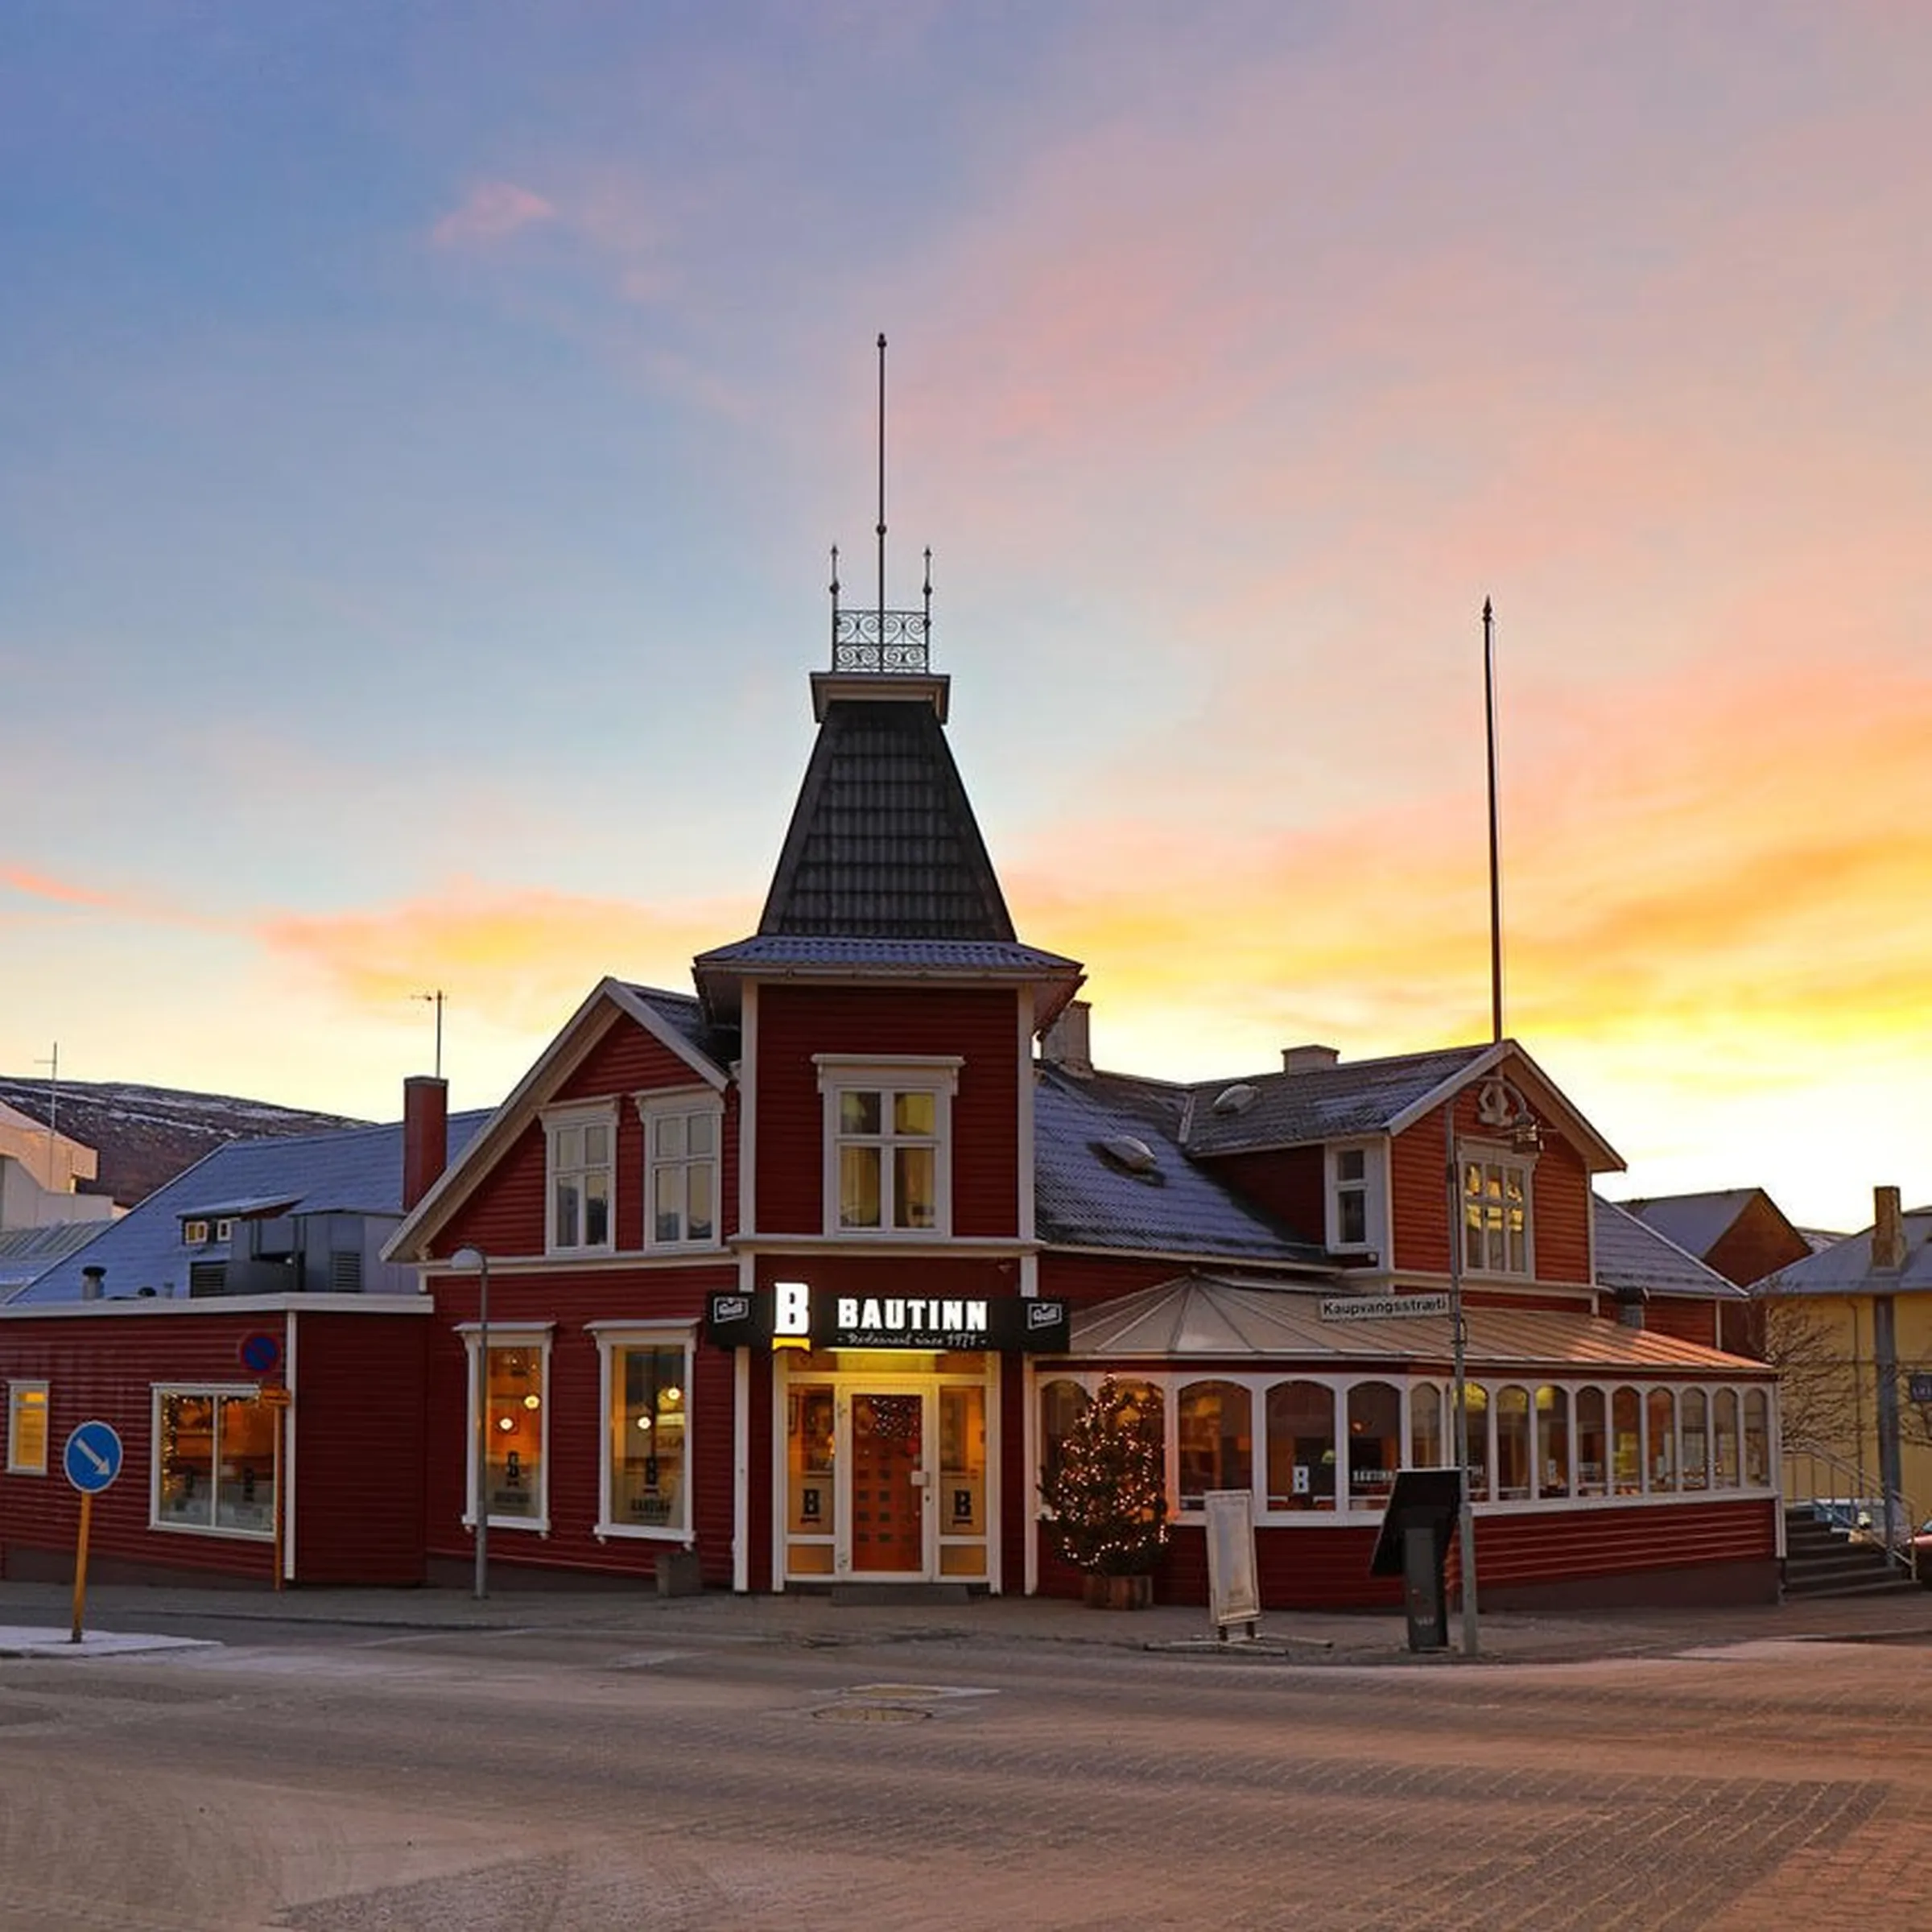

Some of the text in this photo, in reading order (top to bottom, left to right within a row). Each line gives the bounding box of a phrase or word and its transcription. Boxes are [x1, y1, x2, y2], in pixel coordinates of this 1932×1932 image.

[774, 1282, 809, 1334] B
[838, 1298, 988, 1331] BAUTINN
[1323, 1297, 1446, 1315] Kaupvangsstræti
